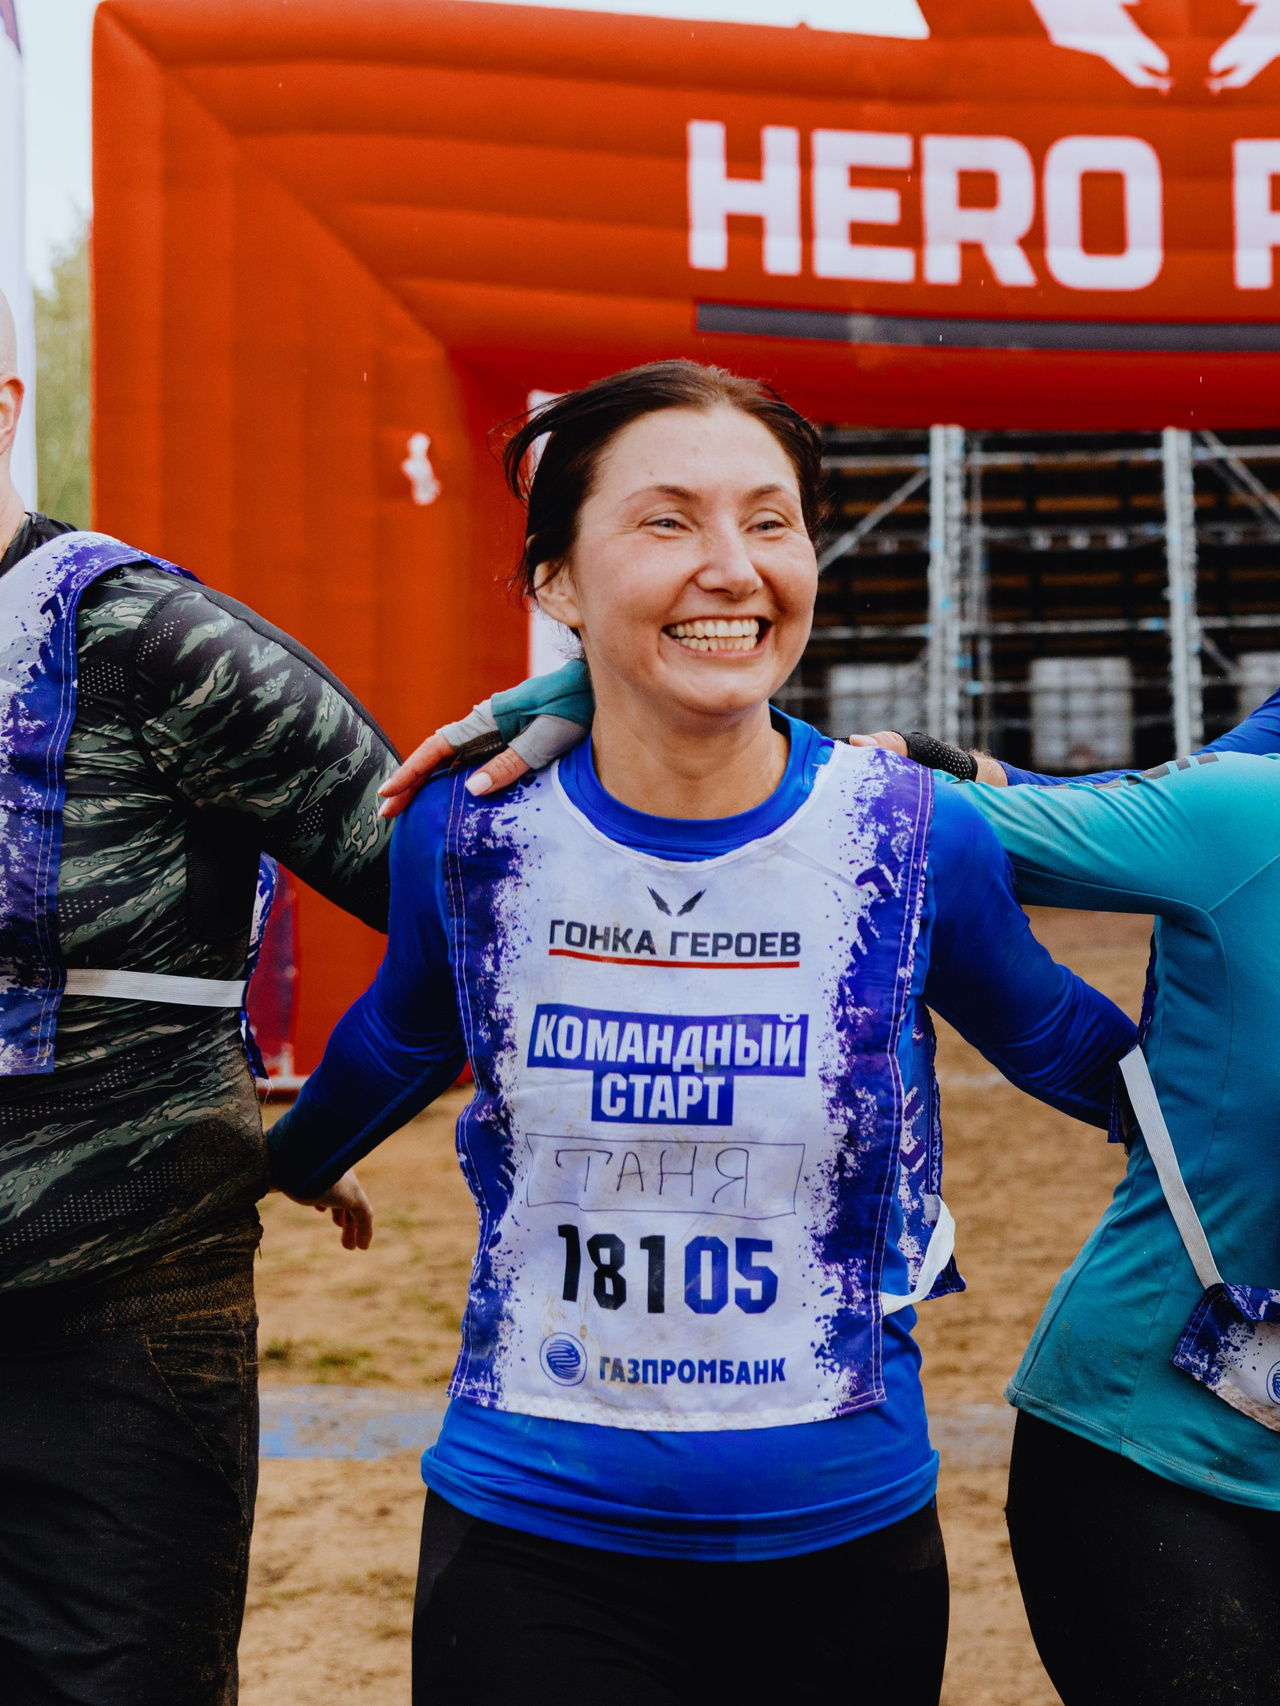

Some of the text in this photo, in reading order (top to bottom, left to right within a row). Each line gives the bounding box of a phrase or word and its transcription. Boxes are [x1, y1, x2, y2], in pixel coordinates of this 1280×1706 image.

[686, 119, 1164, 291] HERO
[549, 919, 802, 958] ГОНКА ГЕРОЕВ
[533, 1012, 802, 1073] КОМАНДНЫЙ
[600, 1072, 726, 1121] СТАРТ
[555, 1145, 749, 1208] ТАНЯ
[557, 1223, 779, 1314] 18105
[600, 1356, 787, 1385] ГАЗПРОМБАНК
